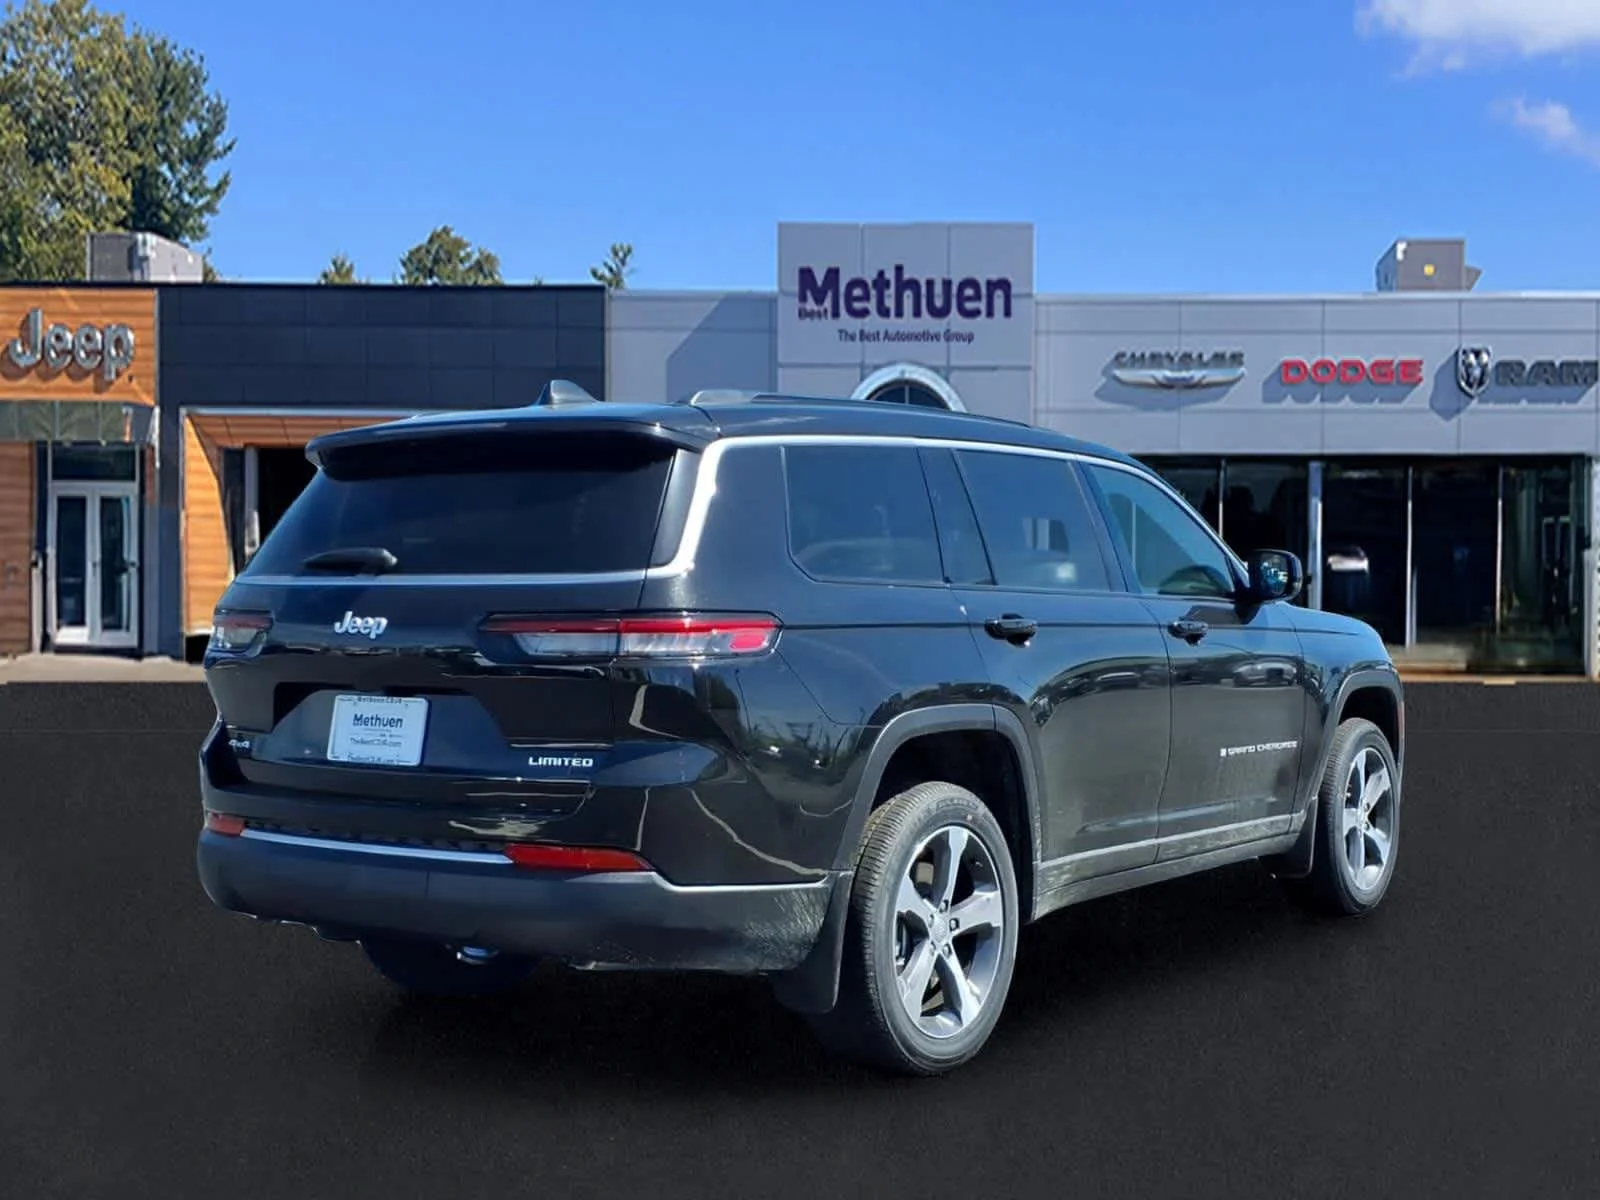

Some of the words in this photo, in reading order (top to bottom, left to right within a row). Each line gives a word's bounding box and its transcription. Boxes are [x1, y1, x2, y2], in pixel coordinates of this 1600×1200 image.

[798, 264, 1012, 319] Methuen
[798, 308, 829, 320] Best
[8, 308, 135, 381] Jeep
[838, 329, 857, 342] The
[859, 329, 881, 342] Best
[883, 329, 941, 342] Automotive
[943, 329, 974, 344] Group
[1114, 351, 1245, 368] CHRYSLER
[1280, 359, 1423, 384] DODGE
[1495, 360, 1599, 386] RAM
[334, 610, 388, 639] Jeep
[352, 713, 404, 728] Methuen
[528, 756, 594, 767] LIMITED
